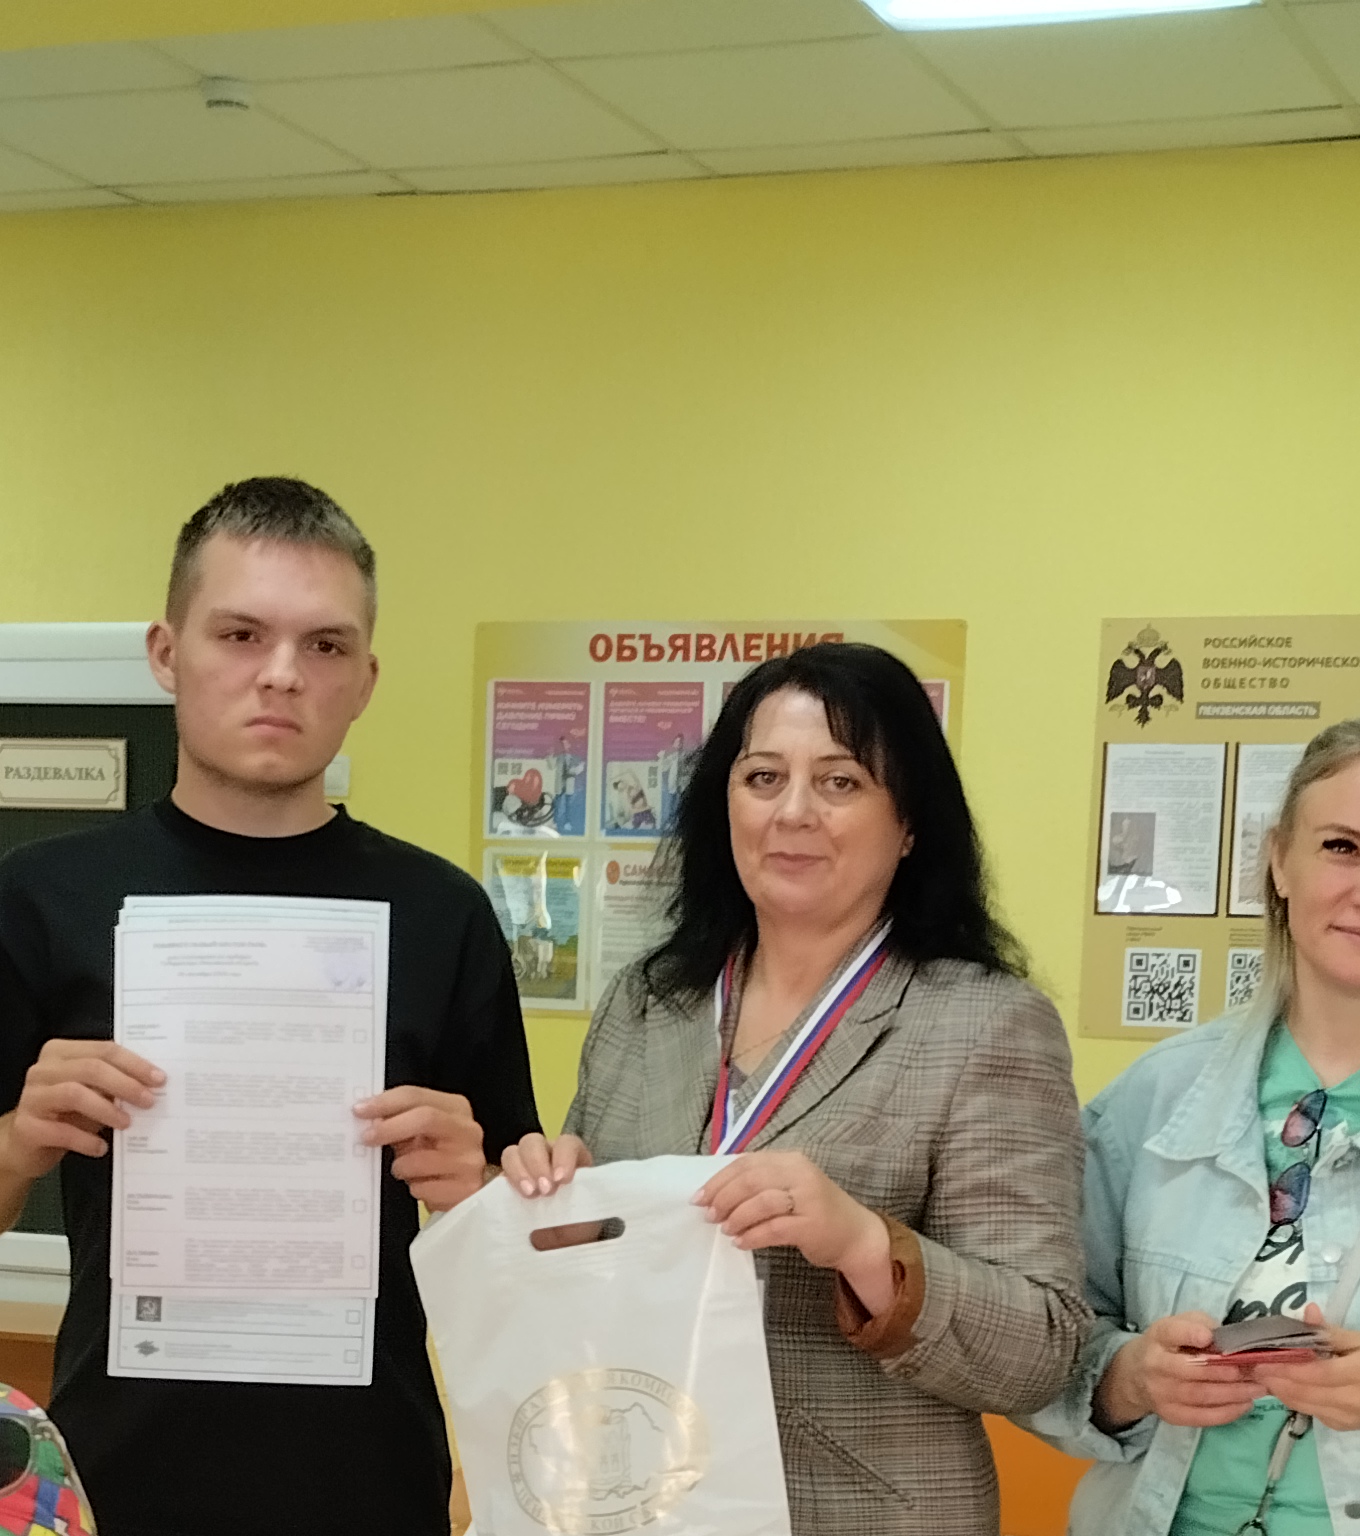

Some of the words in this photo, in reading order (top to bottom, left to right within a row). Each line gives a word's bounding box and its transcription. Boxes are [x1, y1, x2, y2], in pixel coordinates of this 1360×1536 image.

[1203, 635, 1293, 649] РОССИЙСКОЕ
[1201, 677, 1291, 689] ОБЩЕСТВО
[4, 766, 106, 782] РАЗДЕВАЛКА
